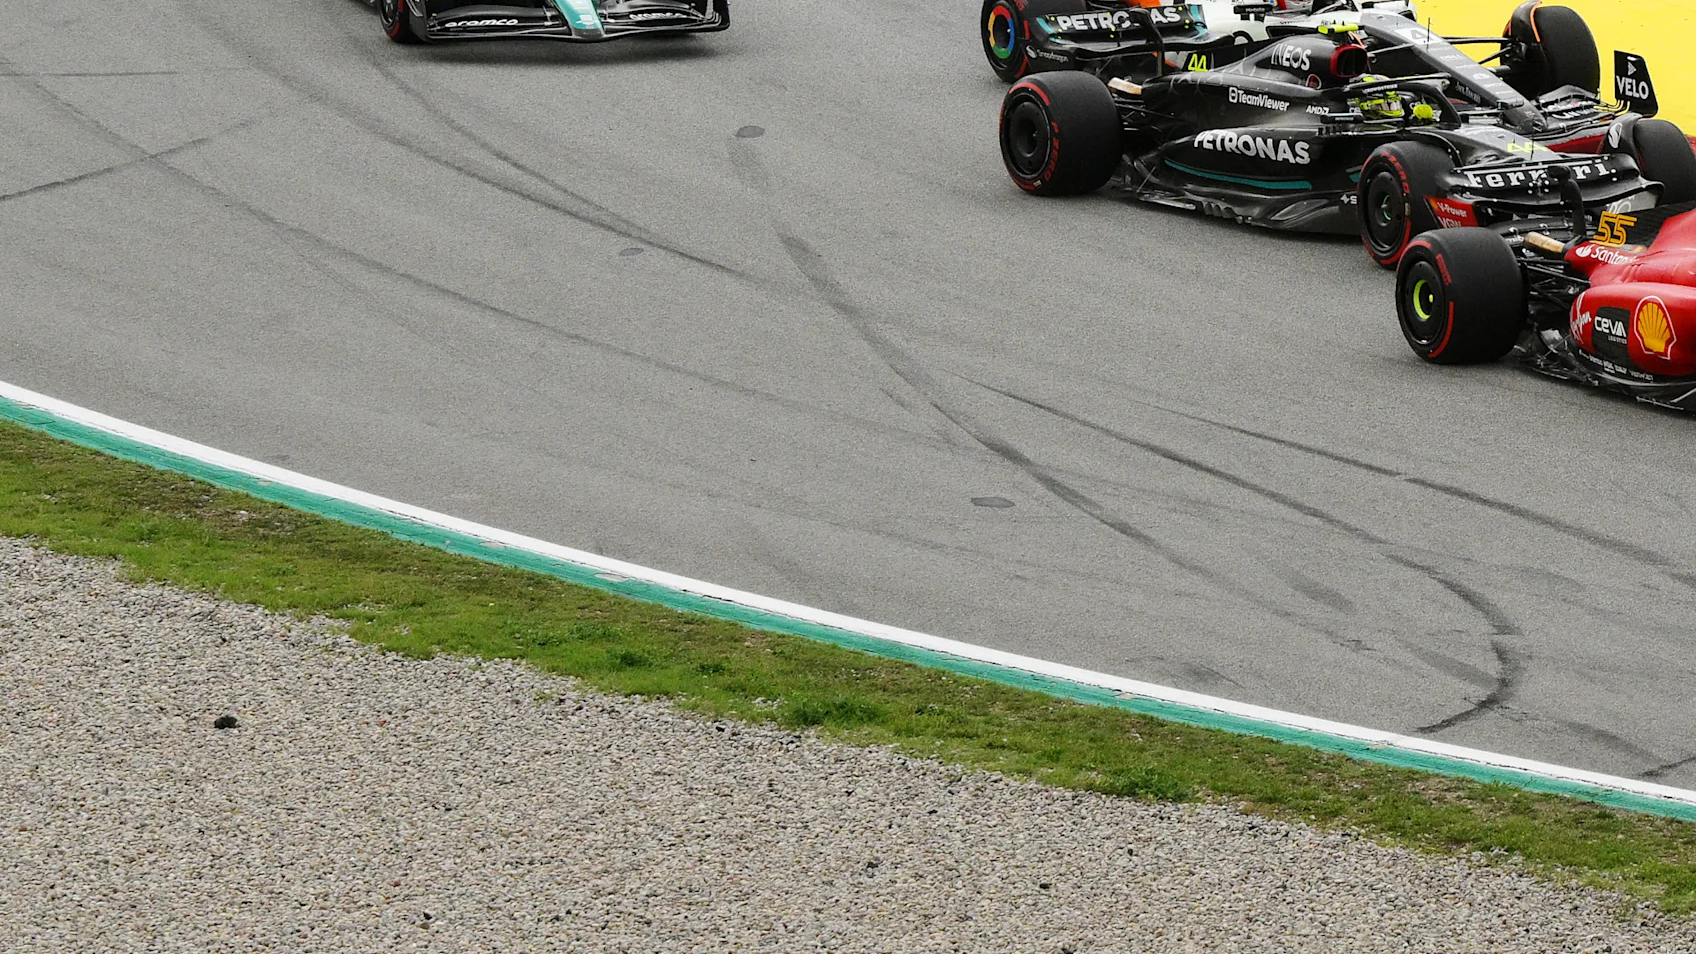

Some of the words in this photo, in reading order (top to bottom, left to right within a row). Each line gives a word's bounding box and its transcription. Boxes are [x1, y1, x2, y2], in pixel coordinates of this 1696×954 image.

[445, 18, 519, 27] aramco
[1056, 7, 1181, 31] PETROAS
[1188, 54, 1207, 72] 44
[1271, 44, 1311, 71] INEOS
[1617, 76, 1649, 99] VELO
[1238, 89, 1290, 112] TeamViewer
[1194, 129, 1310, 164] PETRONAS
[1464, 157, 1610, 188] Ferrri
[1590, 210, 1637, 247] 55
[1590, 246, 1639, 265] Santa
